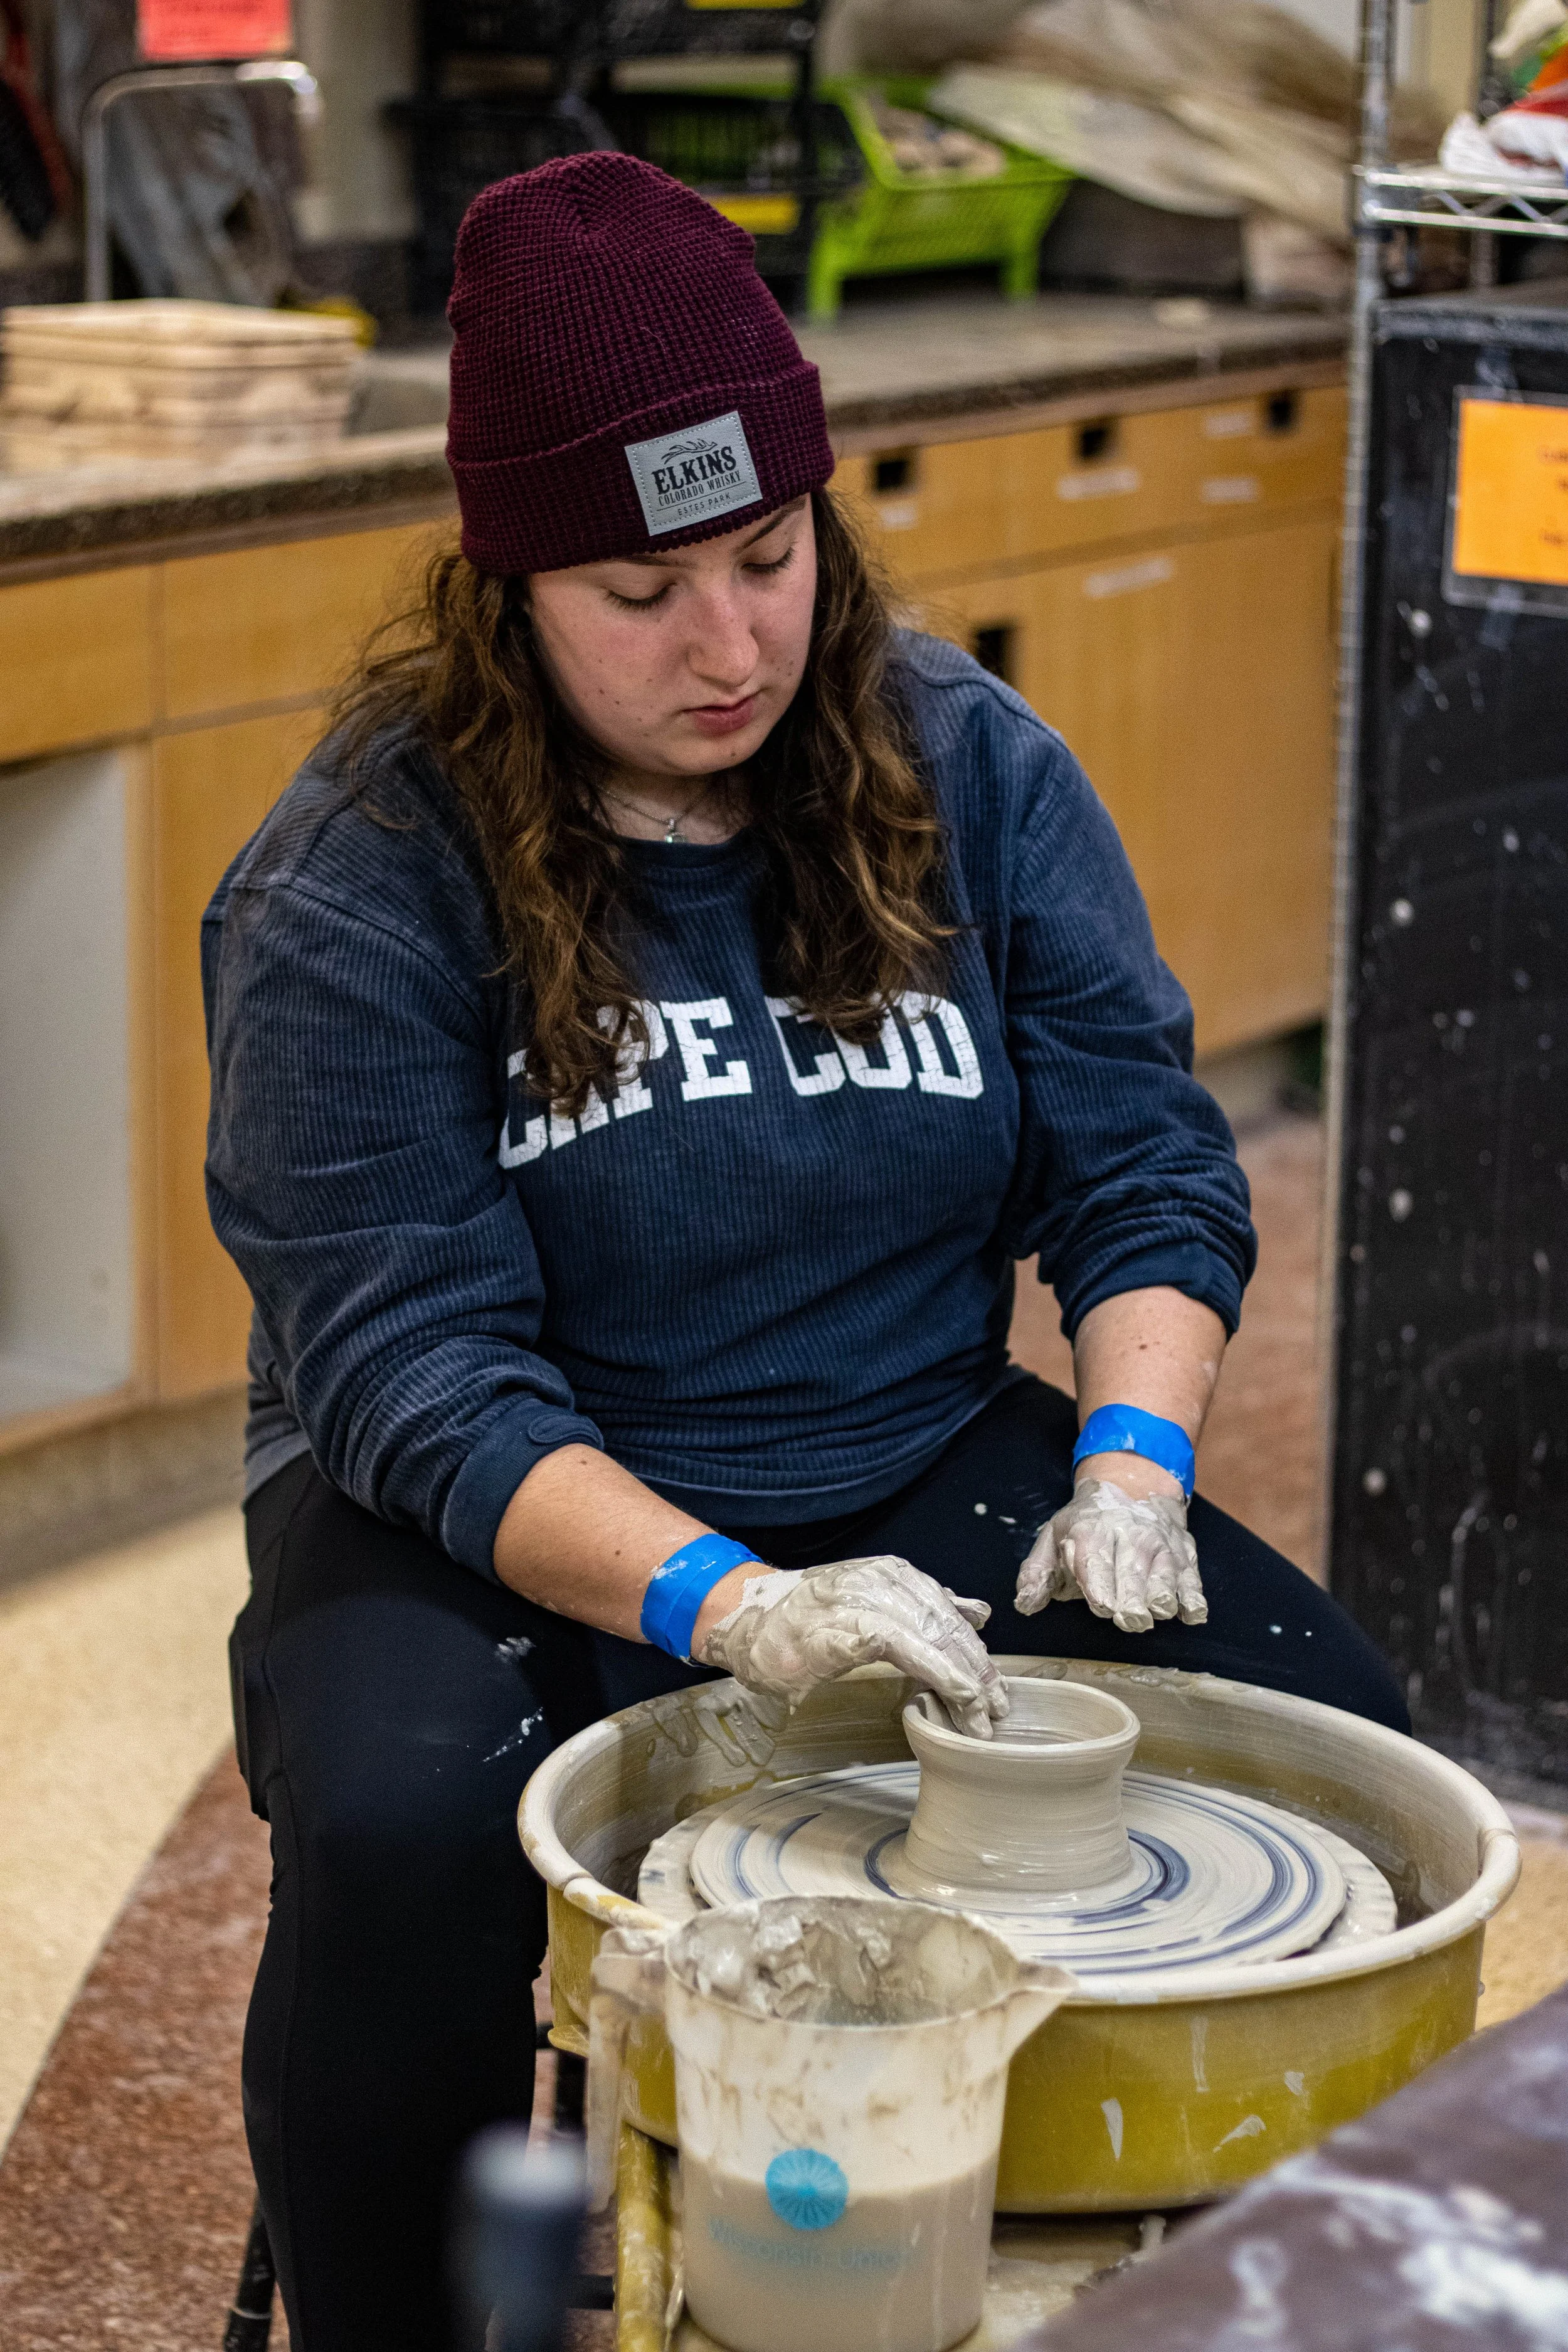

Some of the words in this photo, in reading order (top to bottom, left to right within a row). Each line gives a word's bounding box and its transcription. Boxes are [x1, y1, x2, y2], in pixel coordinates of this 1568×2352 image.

[651, 446, 737, 495] ELKINS
[659, 484, 704, 507] COLORADO
[707, 470, 741, 491] WHISKY
[678, 502, 704, 516] ESTES
[707, 493, 731, 506] PARK
[765, 990, 983, 1099] COD
